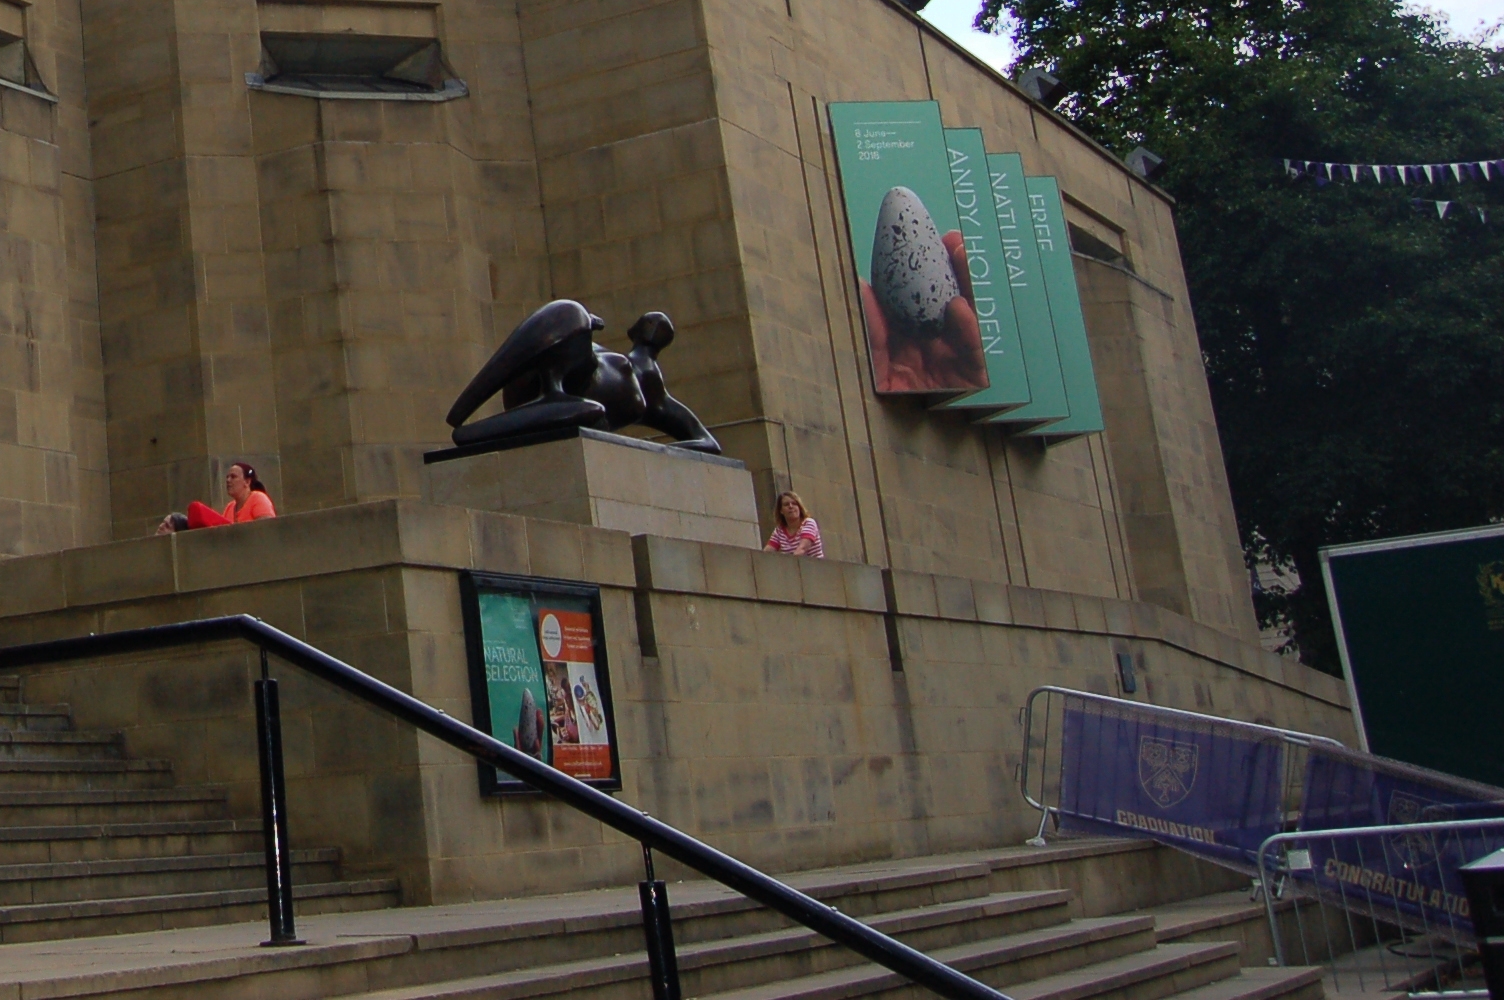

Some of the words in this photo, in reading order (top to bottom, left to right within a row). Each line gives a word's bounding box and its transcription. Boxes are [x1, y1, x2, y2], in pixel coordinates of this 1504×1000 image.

[857, 140, 862, 149] 2
[864, 139, 915, 150] September
[947, 147, 981, 227] ANDY
[484, 646, 528, 664] NATURAL
[485, 664, 538, 682] SELECTION
[1116, 809, 1216, 844] GRADUATION
